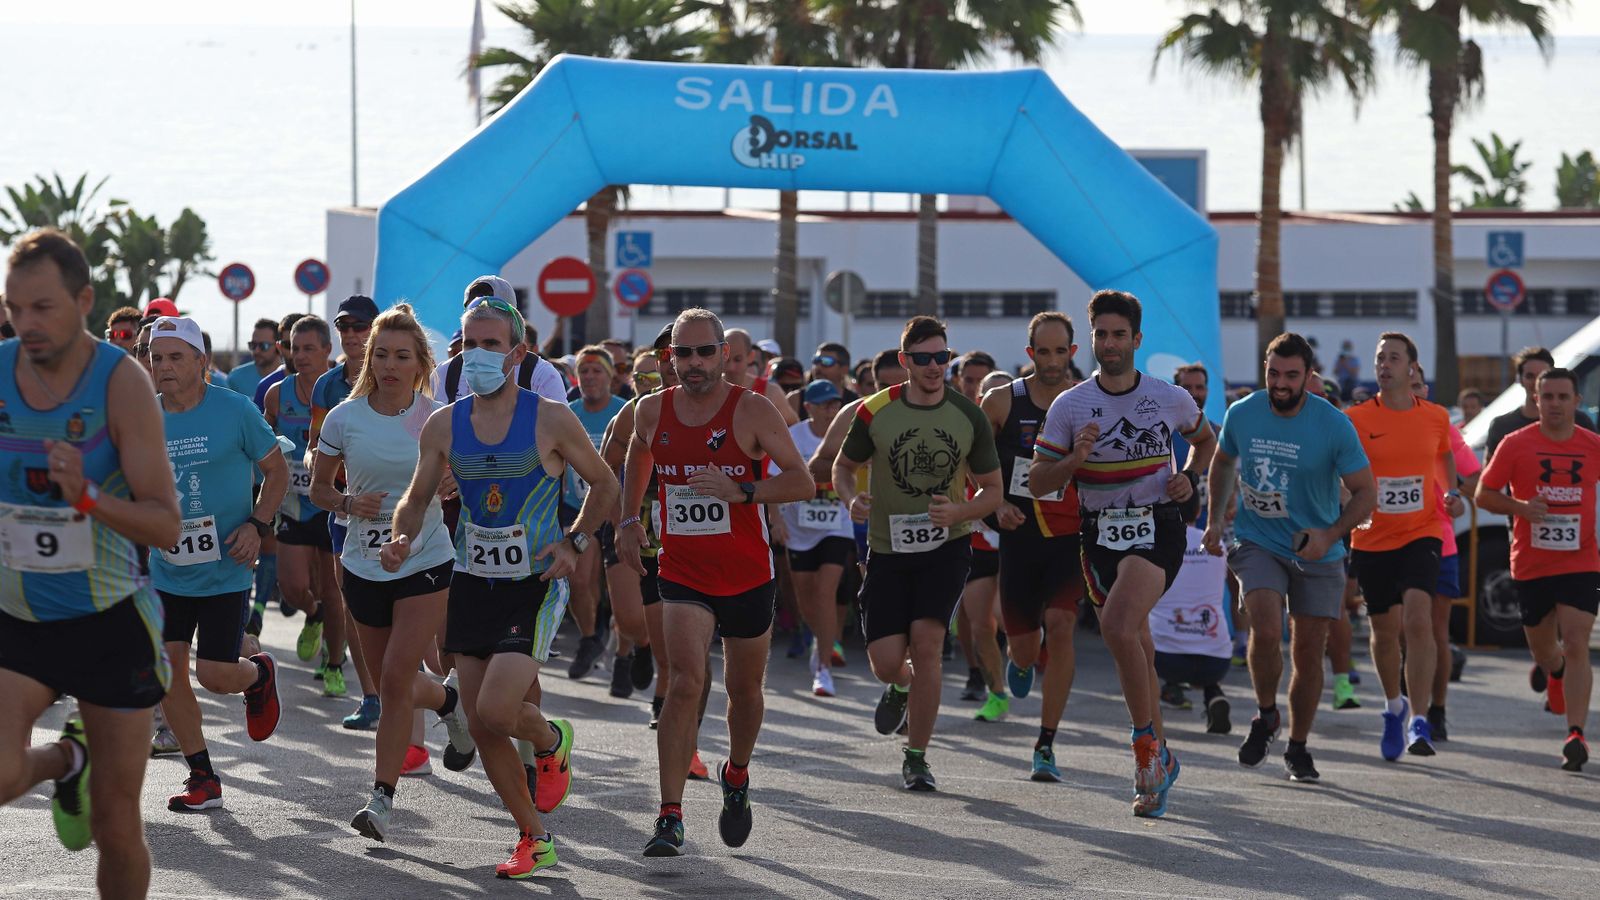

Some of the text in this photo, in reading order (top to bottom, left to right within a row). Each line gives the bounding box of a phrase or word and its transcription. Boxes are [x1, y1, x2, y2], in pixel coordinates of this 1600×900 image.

[674, 76, 899, 118] SALIDA
[749, 114, 858, 158] DORSAL
[167, 436, 208, 446] EDICIÓN
[180, 442, 204, 450] URBANA
[177, 448, 208, 456] ALGECIRAS
[684, 464, 746, 476] PERO
[1385, 489, 1420, 505] 236
[1536, 485, 1582, 495] UNDER
[674, 503, 724, 523] 300
[806, 510, 837, 522] 307
[902, 527, 945, 544] 382
[1107, 522, 1151, 542] 366
[1539, 527, 1576, 541] 233
[36, 532, 58, 557] 9
[473, 545, 523, 566] 210
